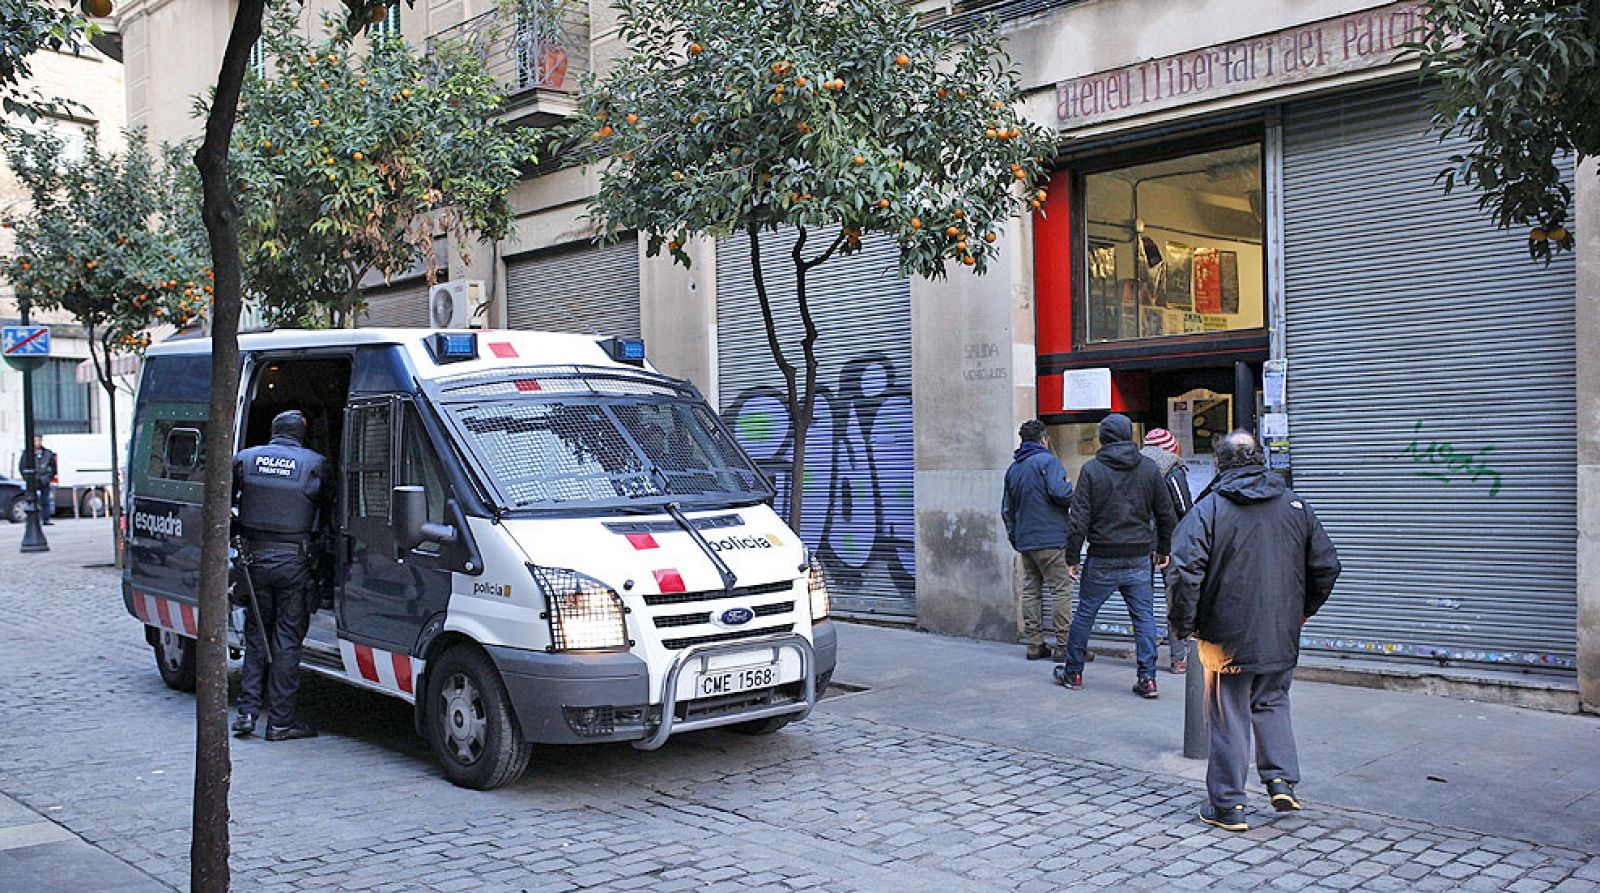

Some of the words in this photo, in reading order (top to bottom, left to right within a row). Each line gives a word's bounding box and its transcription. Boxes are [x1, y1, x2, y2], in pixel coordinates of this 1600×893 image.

[1056, 69, 1132, 120] ateneu
[135, 511, 182, 537] esquadra
[473, 581, 503, 596] policia
[703, 673, 732, 694] CME
[739, 668, 772, 690] 1568
